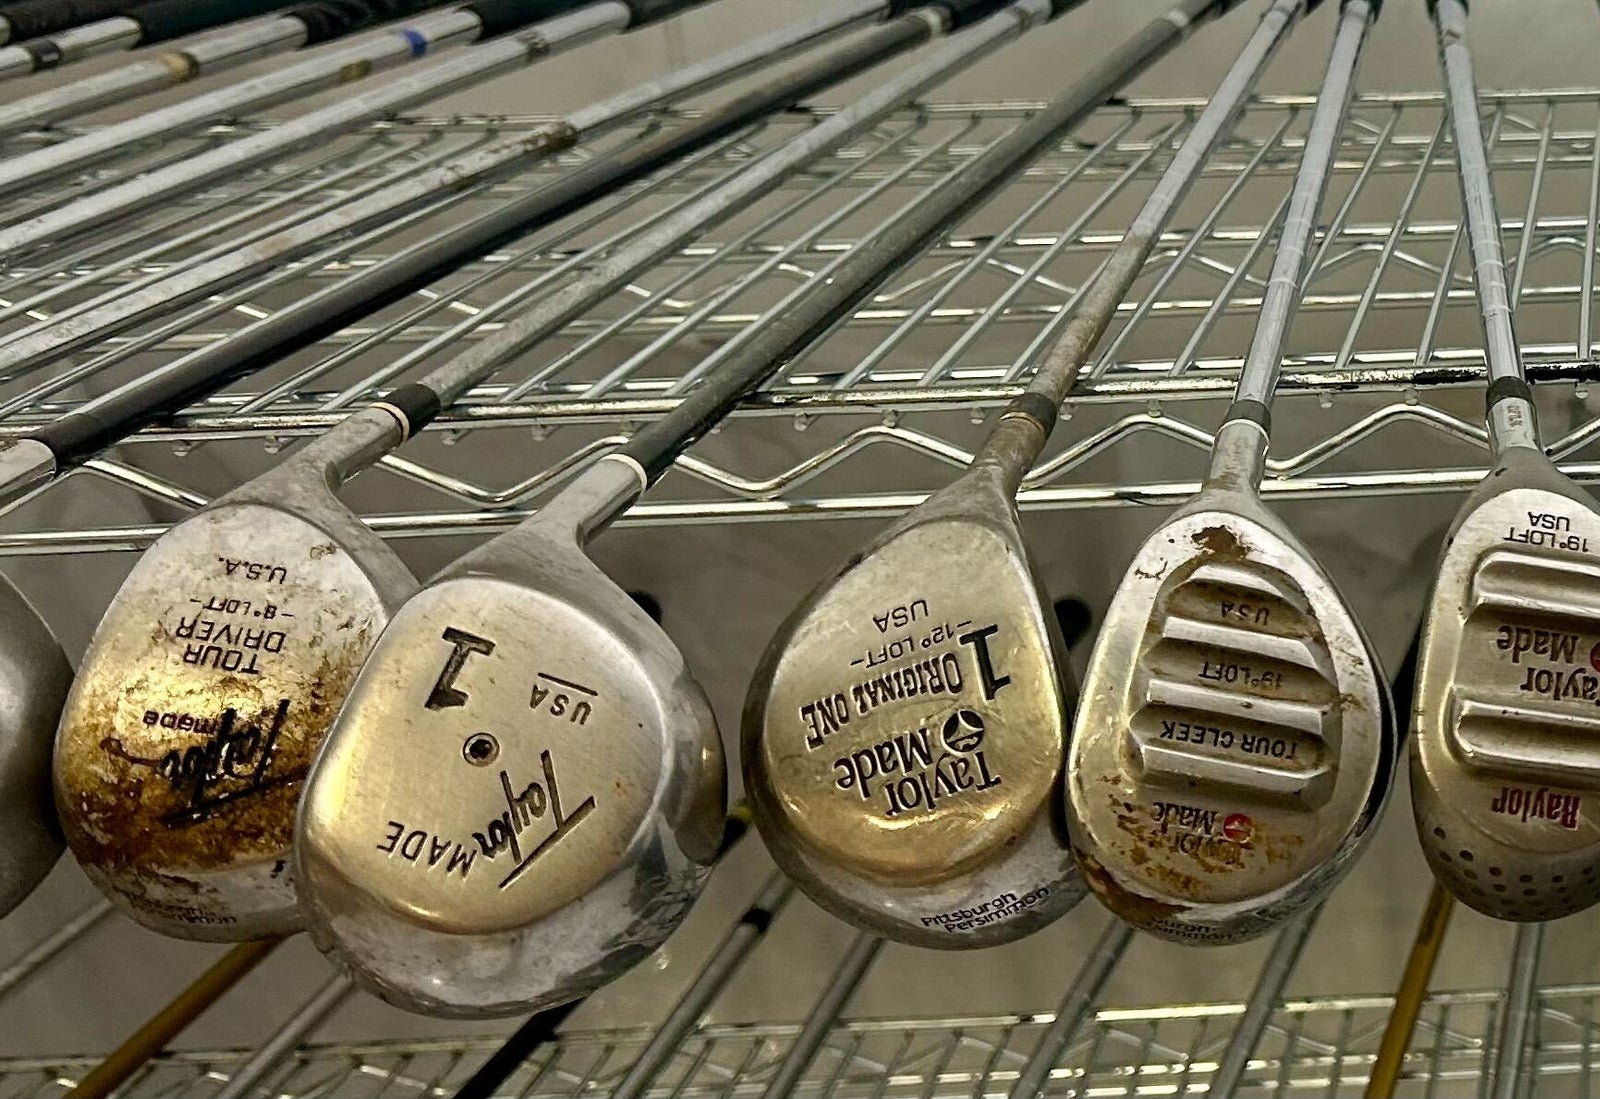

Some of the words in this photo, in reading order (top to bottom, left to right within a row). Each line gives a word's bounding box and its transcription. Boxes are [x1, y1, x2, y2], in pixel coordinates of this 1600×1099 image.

[1528, 511, 1570, 532] USA
[218, 557, 288, 584] U.S.A.
[872, 599, 929, 633] USA
[1221, 600, 1270, 626] USA
[175, 617, 286, 653] DRIVER
[1496, 624, 1580, 664] Made
[182, 643, 260, 675] TOUR
[424, 626, 496, 710] 1
[959, 623, 1011, 703] 1
[852, 652, 964, 716] ORIGINAL
[143, 710, 218, 733] made
[529, 684, 592, 725] USA
[799, 691, 851, 752] ONE
[1160, 720, 1236, 748] CLEEK
[1241, 733, 1297, 760] TOUR
[833, 727, 934, 801] Made
[885, 751, 1002, 816] Taylor
[472, 750, 596, 889] Taylor
[1491, 786, 1581, 831] Raylor
[377, 821, 477, 879] MADE
[920, 890, 1018, 927] Pittsburgh
[944, 886, 1050, 933] Persimmon
